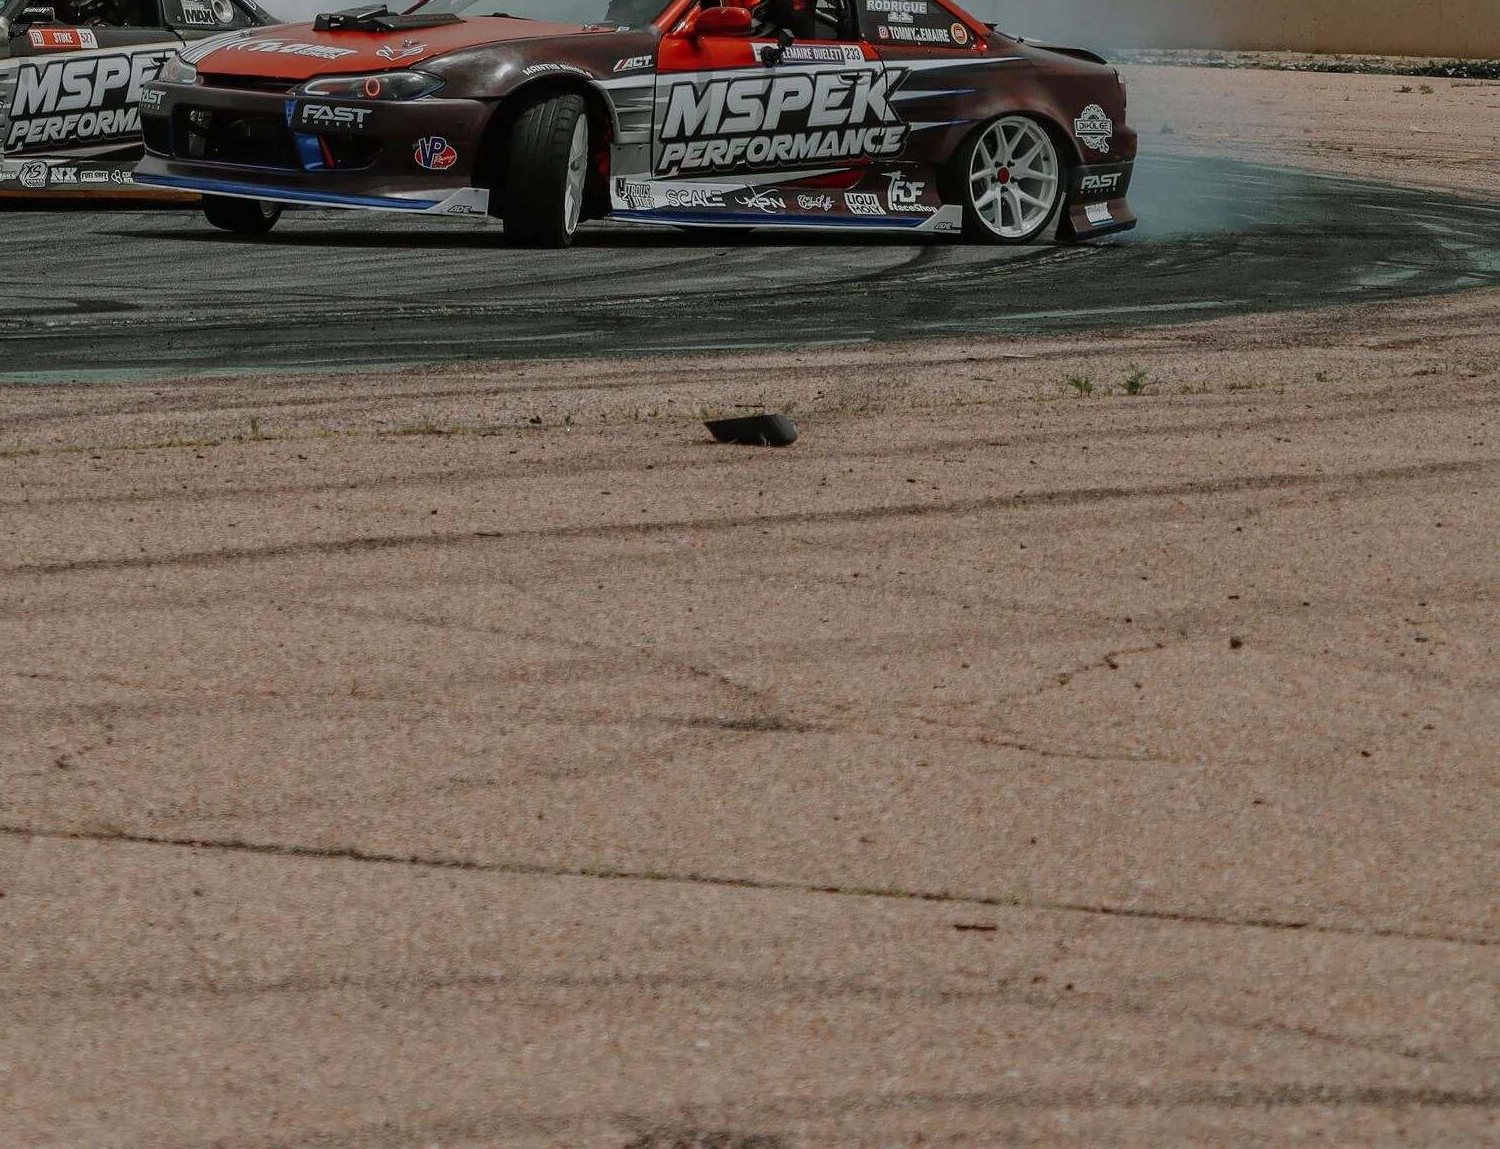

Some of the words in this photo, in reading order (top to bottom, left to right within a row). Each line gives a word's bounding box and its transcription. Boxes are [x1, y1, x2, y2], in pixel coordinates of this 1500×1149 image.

[866, 0, 927, 14] RODRIGUE
[185, 9, 214, 23] MAX
[53, 32, 73, 43] STUKE
[624, 55, 652, 67] ACT
[845, 48, 861, 60] 233
[11, 52, 173, 116] MSPE
[662, 70, 902, 139] MSPEK
[302, 104, 372, 122] FAST
[8, 107, 142, 145] PERFORMA
[302, 119, 363, 129] WHEELS
[418, 136, 447, 168] VP
[658, 125, 906, 170] PERFORMANCE
[25, 164, 41, 178] XS
[50, 167, 77, 183] NX
[616, 178, 650, 197] NITROUS
[1081, 173, 1122, 189] FAST
[665, 189, 726, 207] SCALE
[846, 195, 875, 205] LIQUI
[852, 205, 882, 214] MOLY
